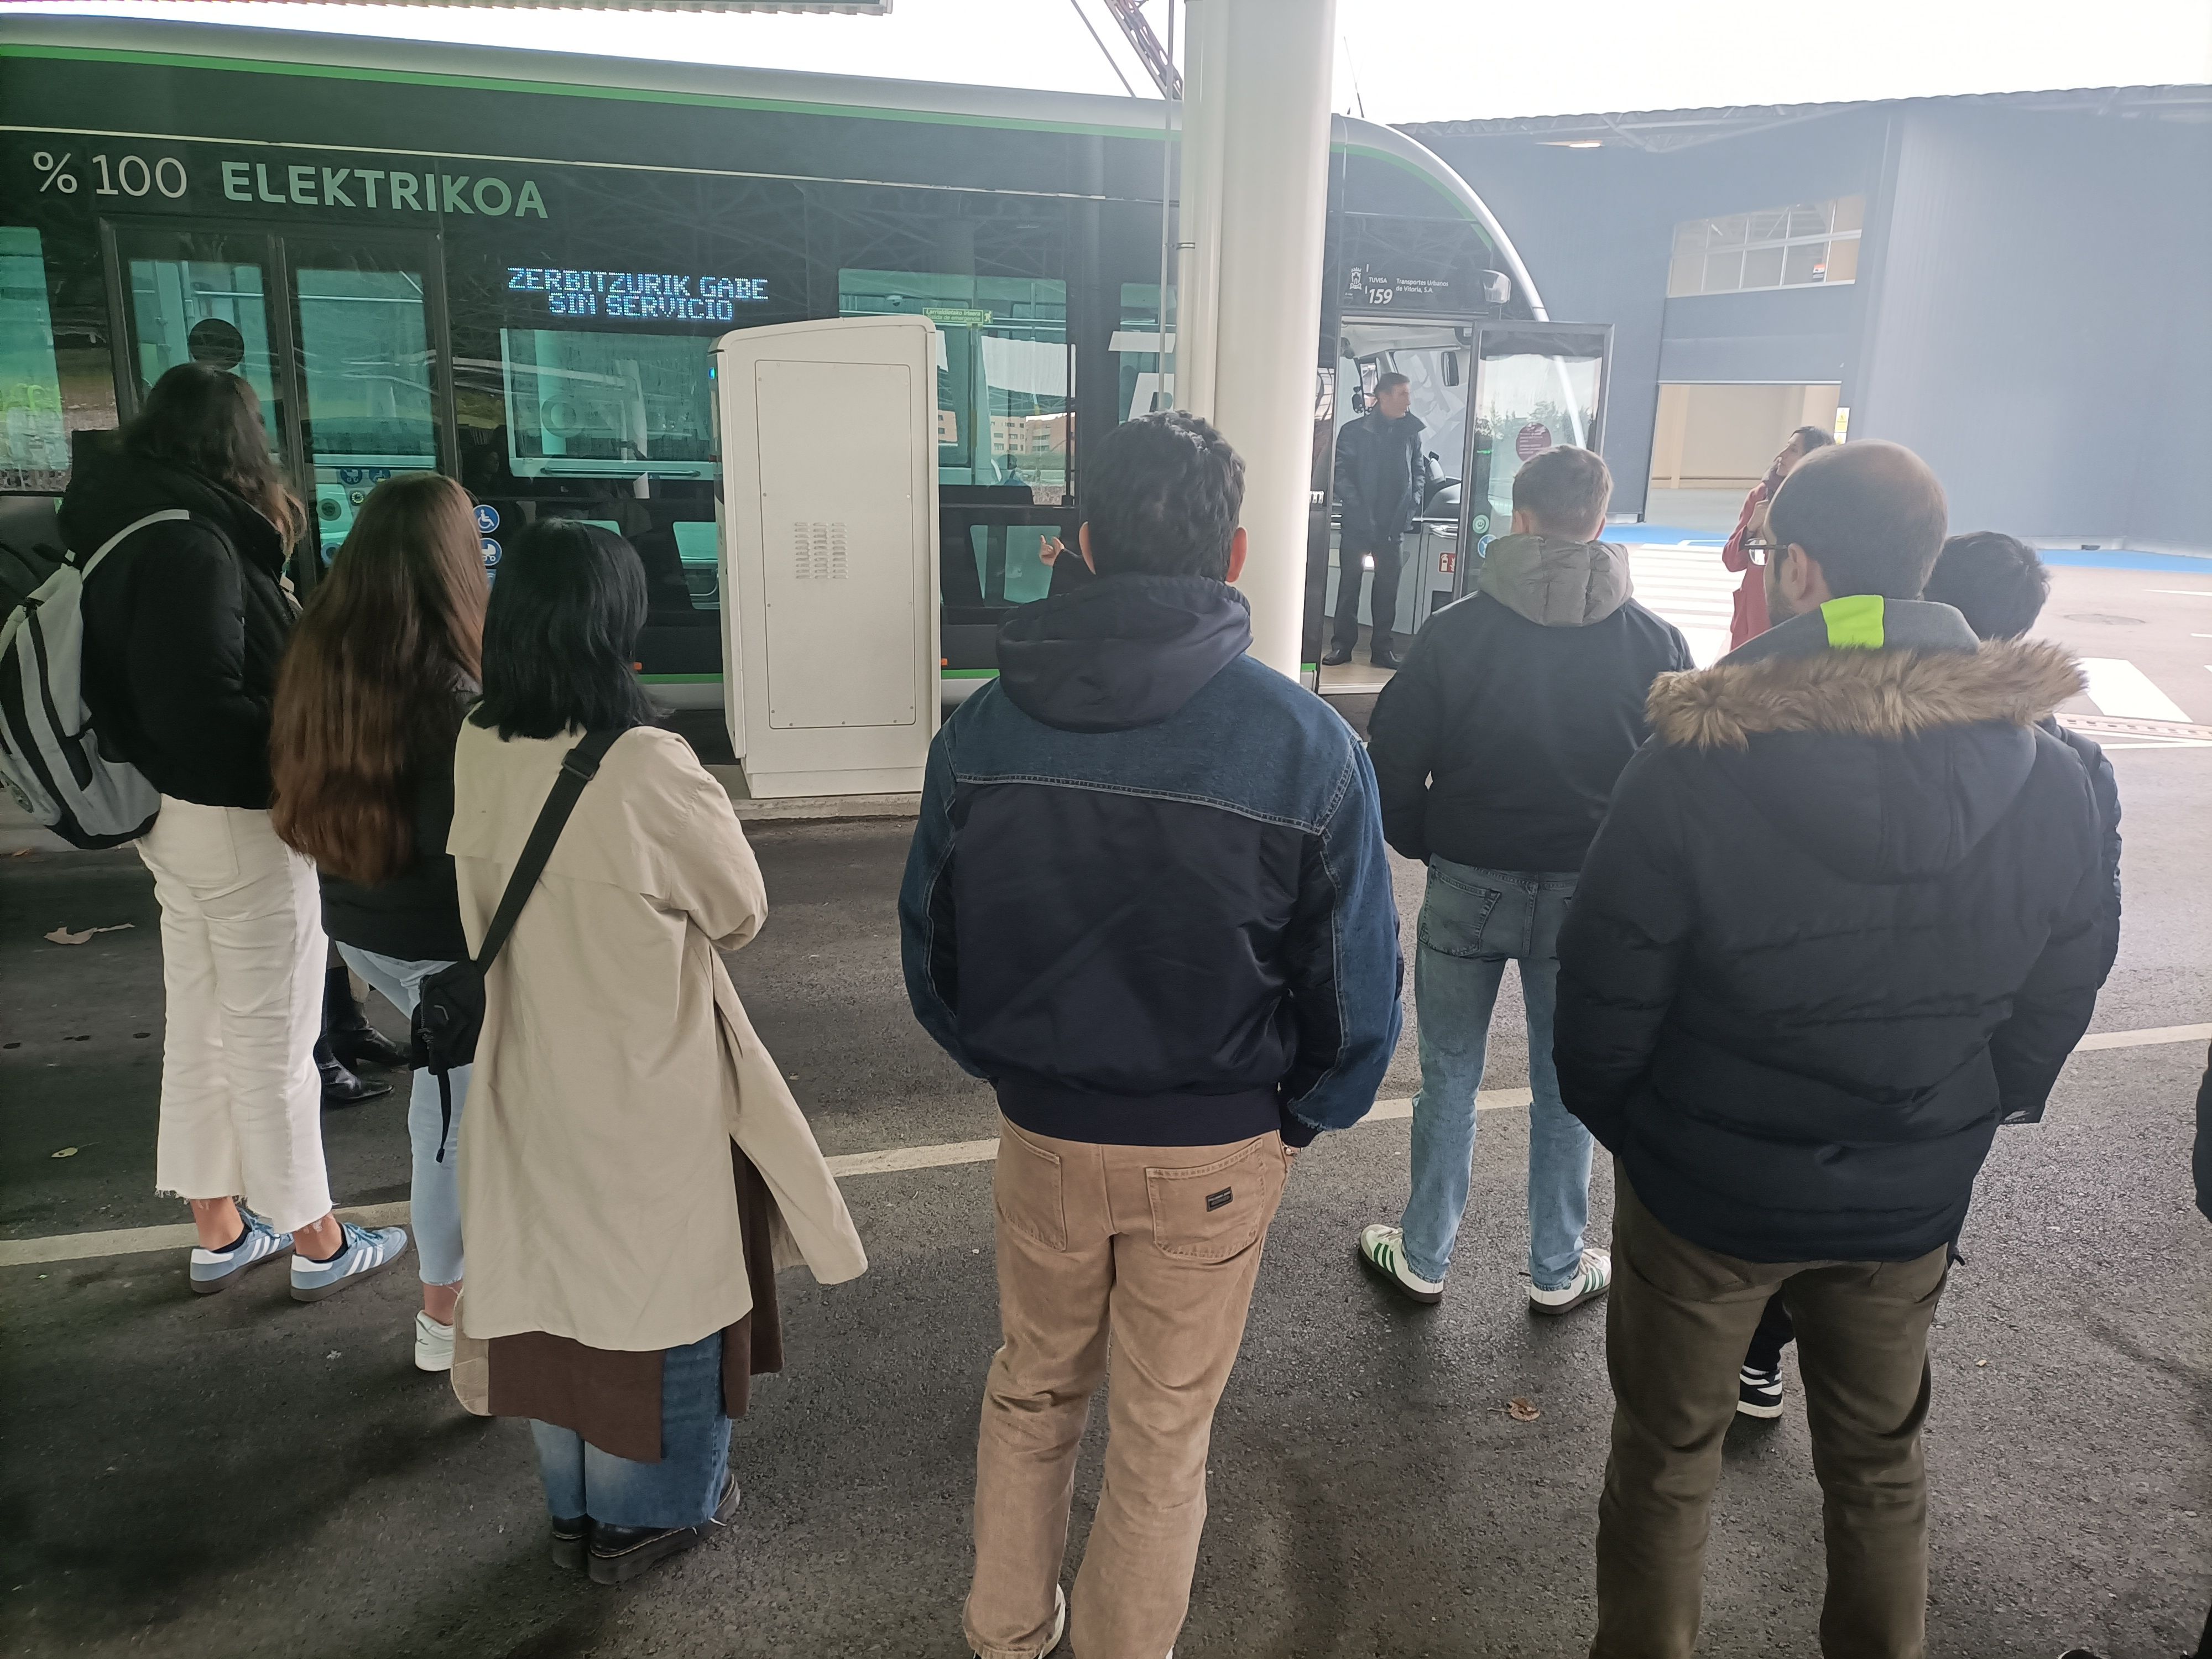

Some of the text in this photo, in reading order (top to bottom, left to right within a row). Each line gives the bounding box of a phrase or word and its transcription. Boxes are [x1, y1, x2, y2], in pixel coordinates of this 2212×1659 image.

[92, 154, 187, 198] 100
[222, 161, 548, 218] ELEKTRIKOA
[507, 267, 768, 300] ZERBITZURIK GABE
[1369, 288, 1393, 304] 159
[549, 293, 733, 320] SIN SERVICIO
